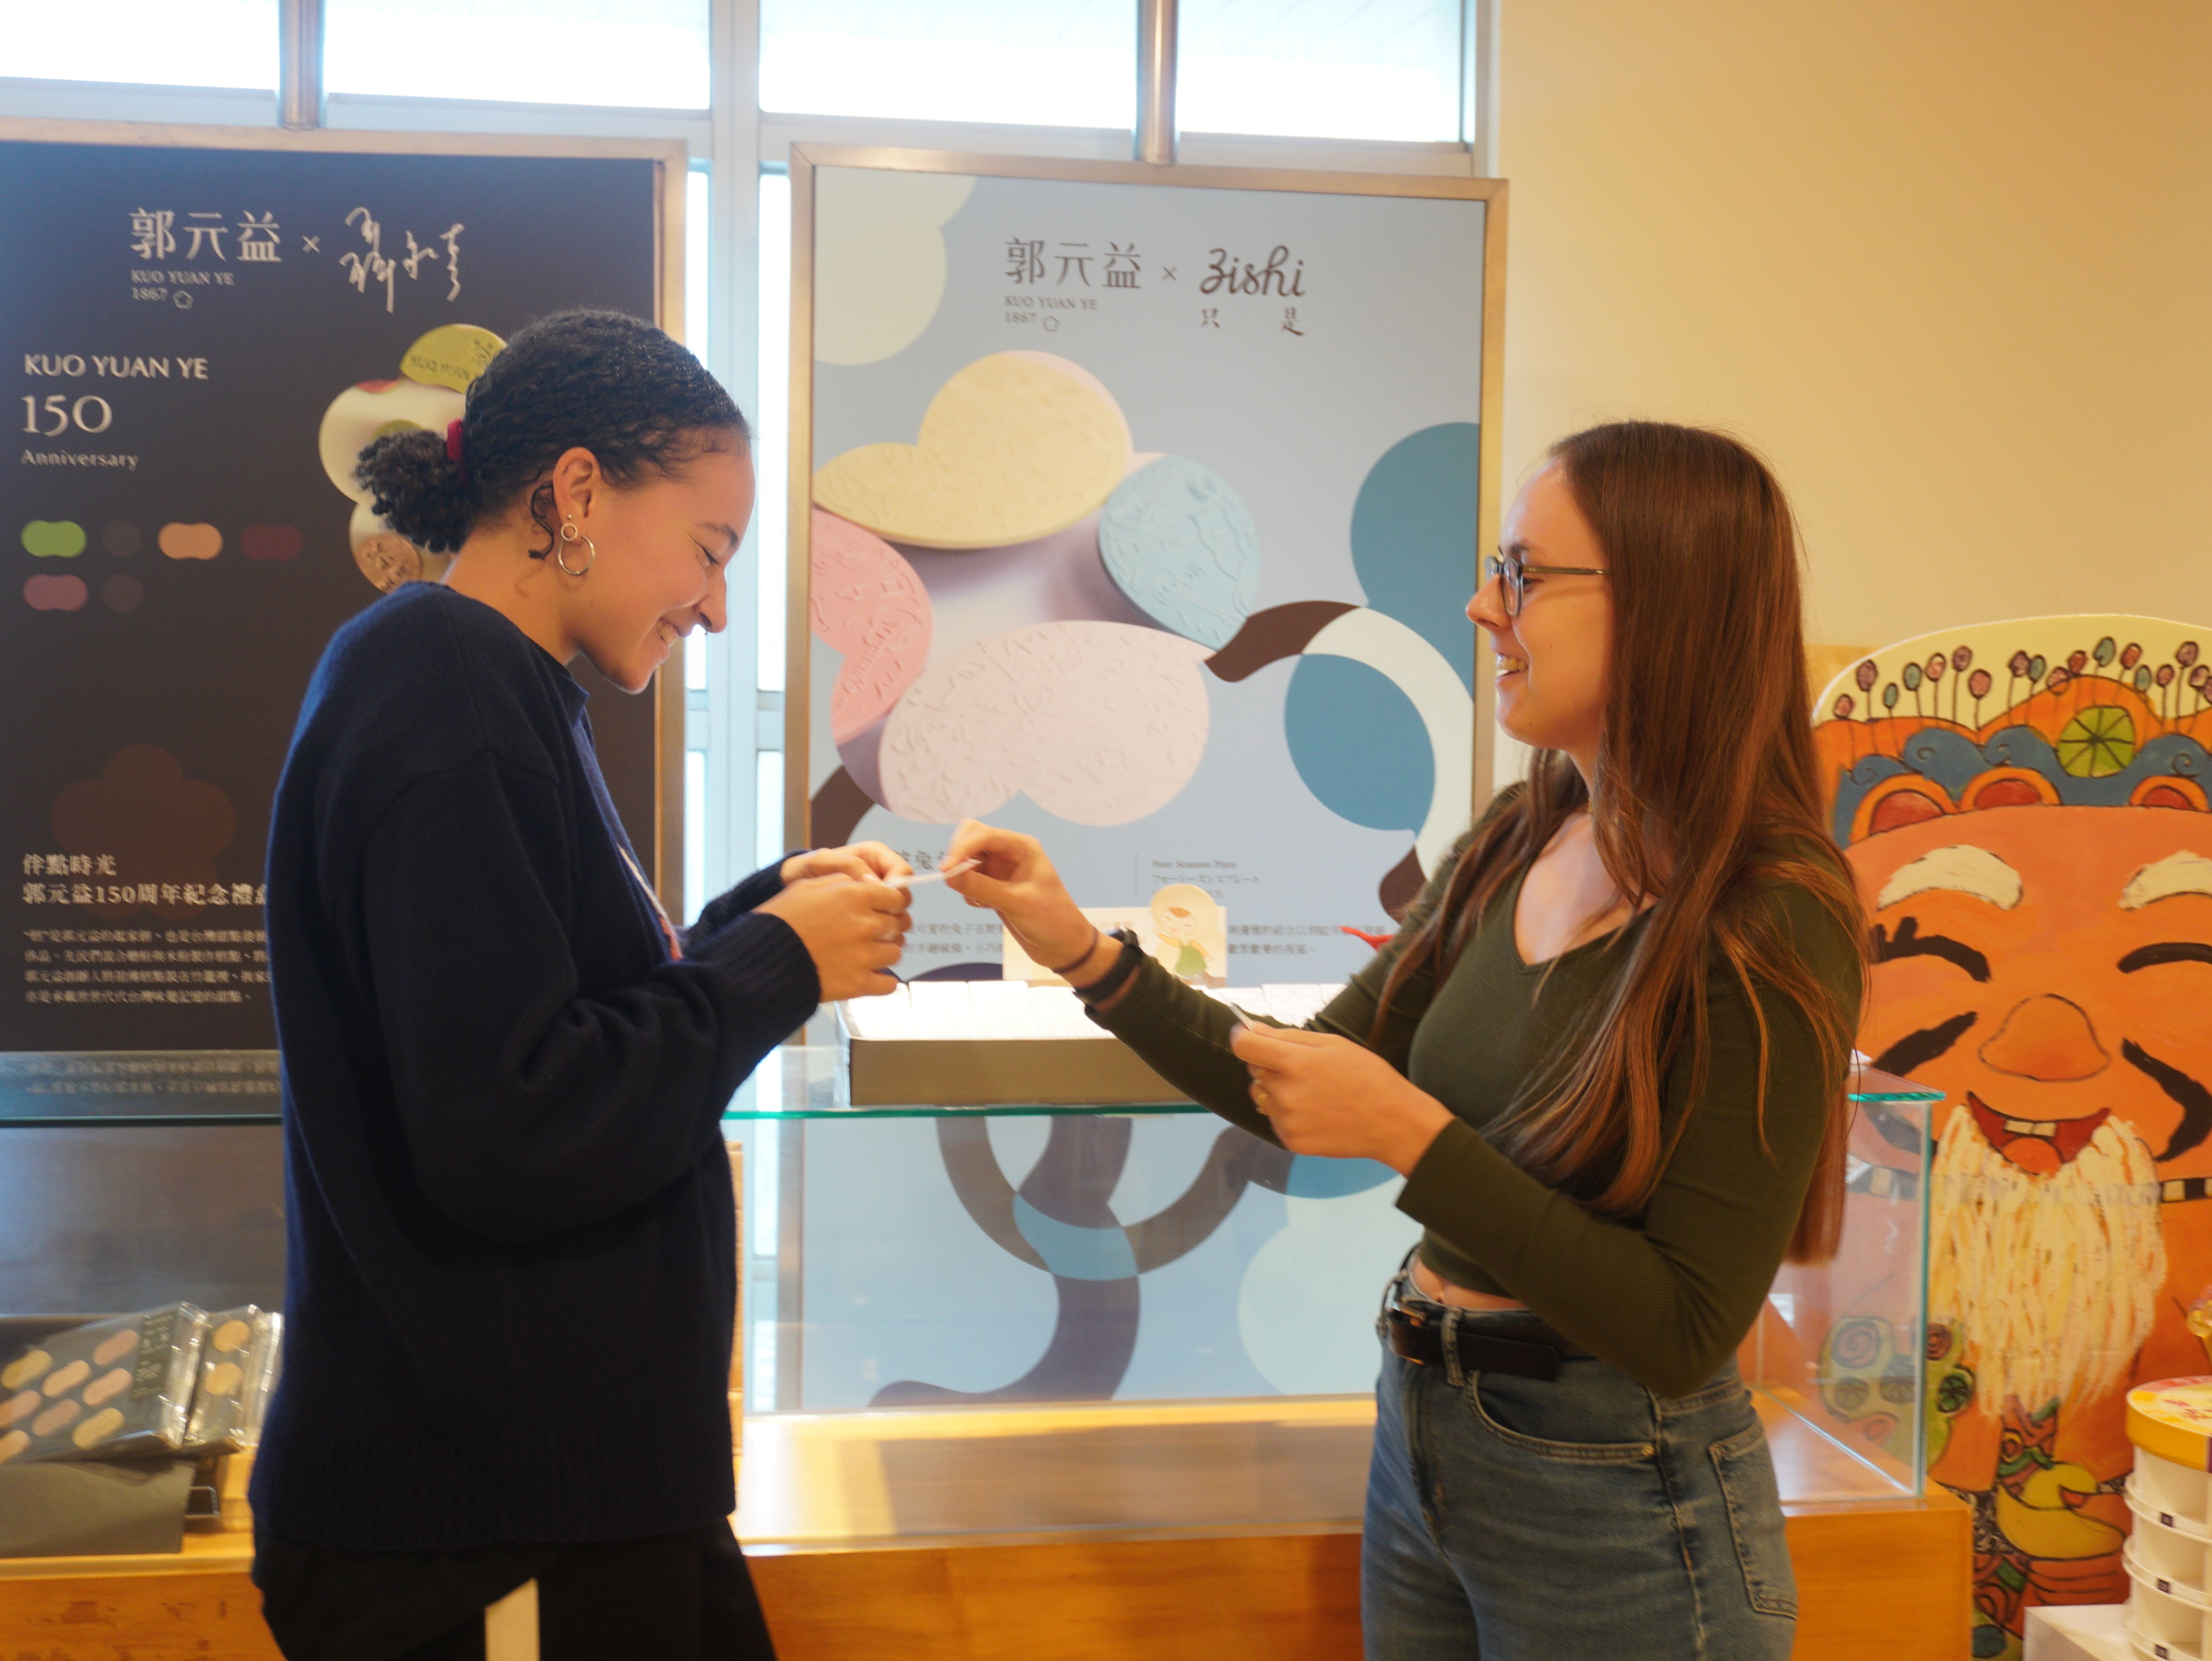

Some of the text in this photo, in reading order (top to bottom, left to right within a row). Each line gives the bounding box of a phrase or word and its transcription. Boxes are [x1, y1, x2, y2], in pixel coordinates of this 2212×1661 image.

[129, 207, 282, 262] 郭元益
[1005, 236, 1142, 289] 郭元益
[131, 270, 235, 286] KUO YUAN YE
[132, 287, 168, 301] 1867
[1004, 295, 1098, 310] KUO YUAN YE
[1005, 312, 1036, 323] 1867
[24, 354, 208, 380] KUO YUAN YE
[21, 394, 113, 437] 150
[20, 449, 139, 472] Anniversary
